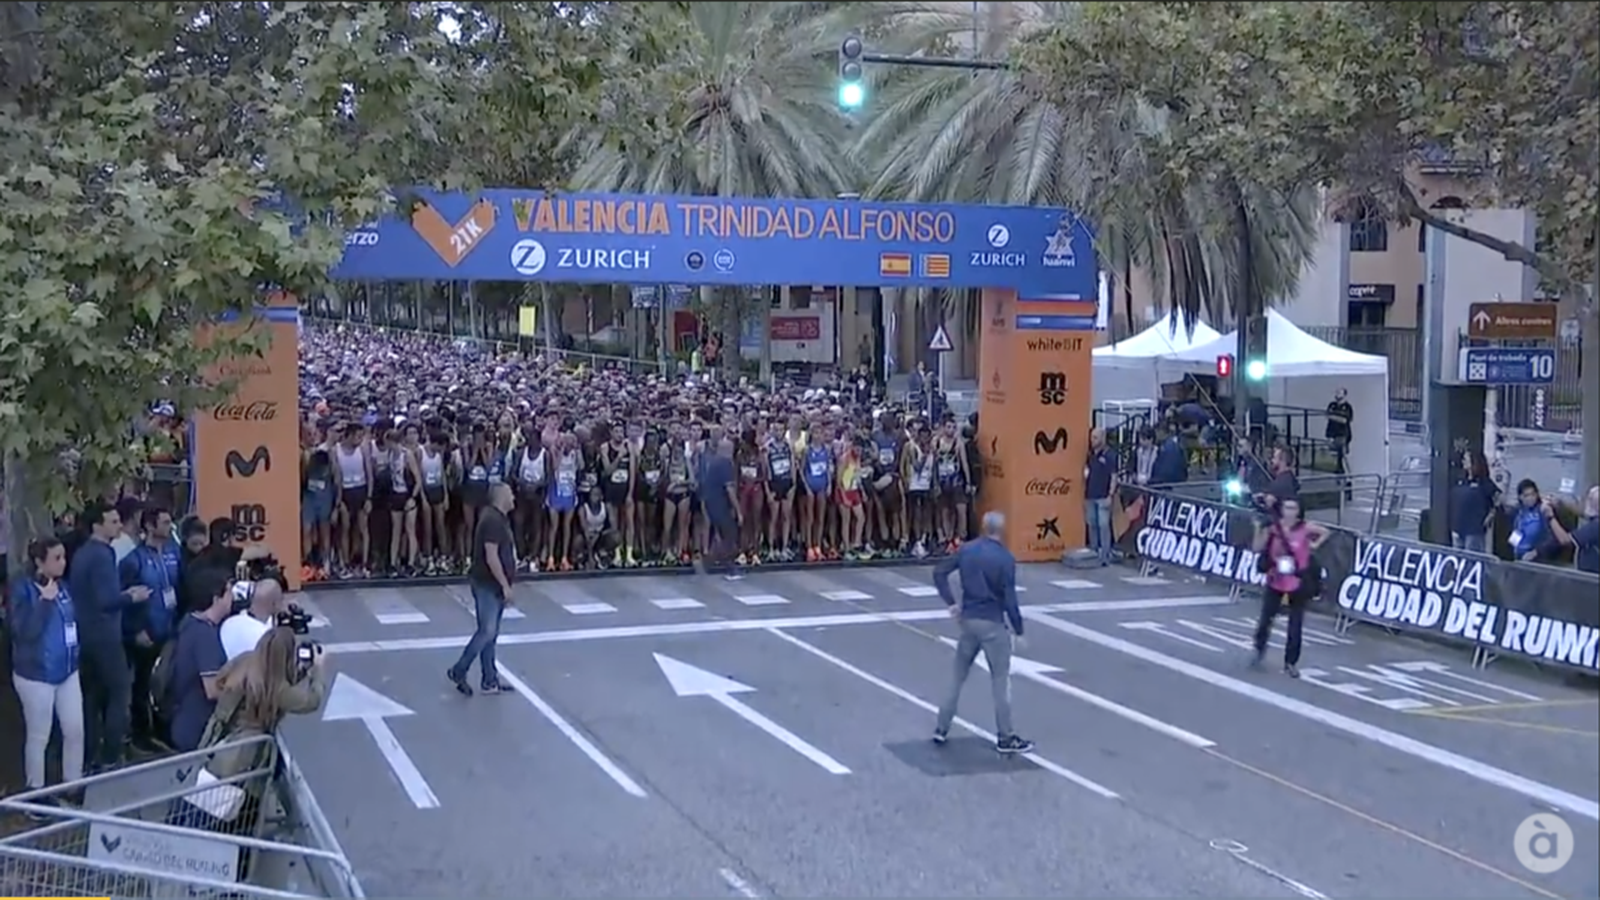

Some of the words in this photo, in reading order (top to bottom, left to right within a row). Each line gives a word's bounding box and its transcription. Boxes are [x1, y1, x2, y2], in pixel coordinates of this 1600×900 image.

[450, 218, 484, 256] 21K
[512, 197, 670, 236] VALENCIA
[677, 202, 815, 240] TRINIDAD
[818, 207, 955, 243] ALFONSO
[557, 248, 650, 270] ZURICH
[969, 251, 1026, 267] ZURICH
[1529, 355, 1553, 379] 10
[1146, 495, 1228, 543] VALENCIA
[1136, 526, 1203, 569] CIUDAD
[1201, 540, 1237, 579] DEL
[1353, 537, 1483, 600] VALENCIA
[1337, 575, 1443, 628] CIUDAD
[1443, 596, 1499, 645] DEL
[1500, 609, 1598, 669] RUNNI
